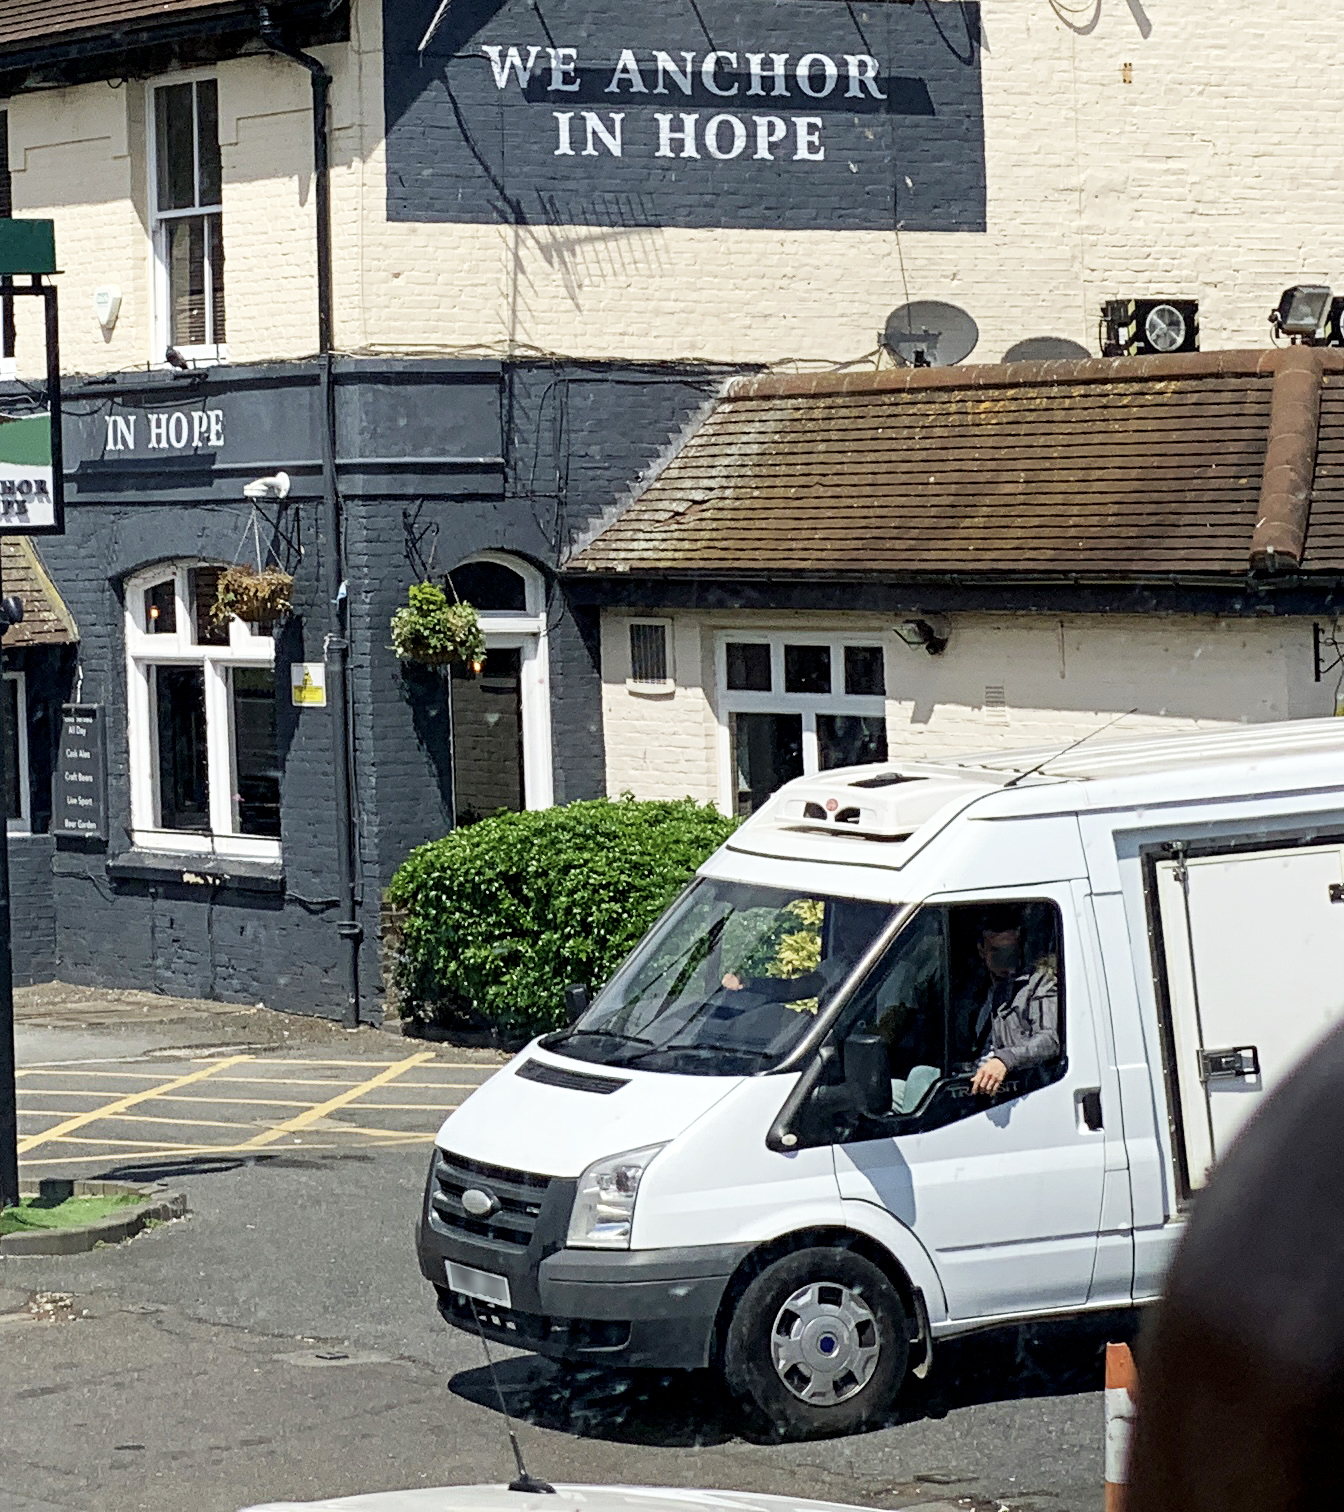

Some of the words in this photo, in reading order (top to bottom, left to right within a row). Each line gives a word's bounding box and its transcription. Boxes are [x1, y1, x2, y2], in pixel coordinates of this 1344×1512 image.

[481, 44, 581, 92] WE
[604, 48, 888, 100] ANCHOR
[552, 110, 626, 157] IN
[653, 111, 825, 161] HOPE
[104, 415, 137, 451] IN
[147, 409, 225, 449] HOPE
